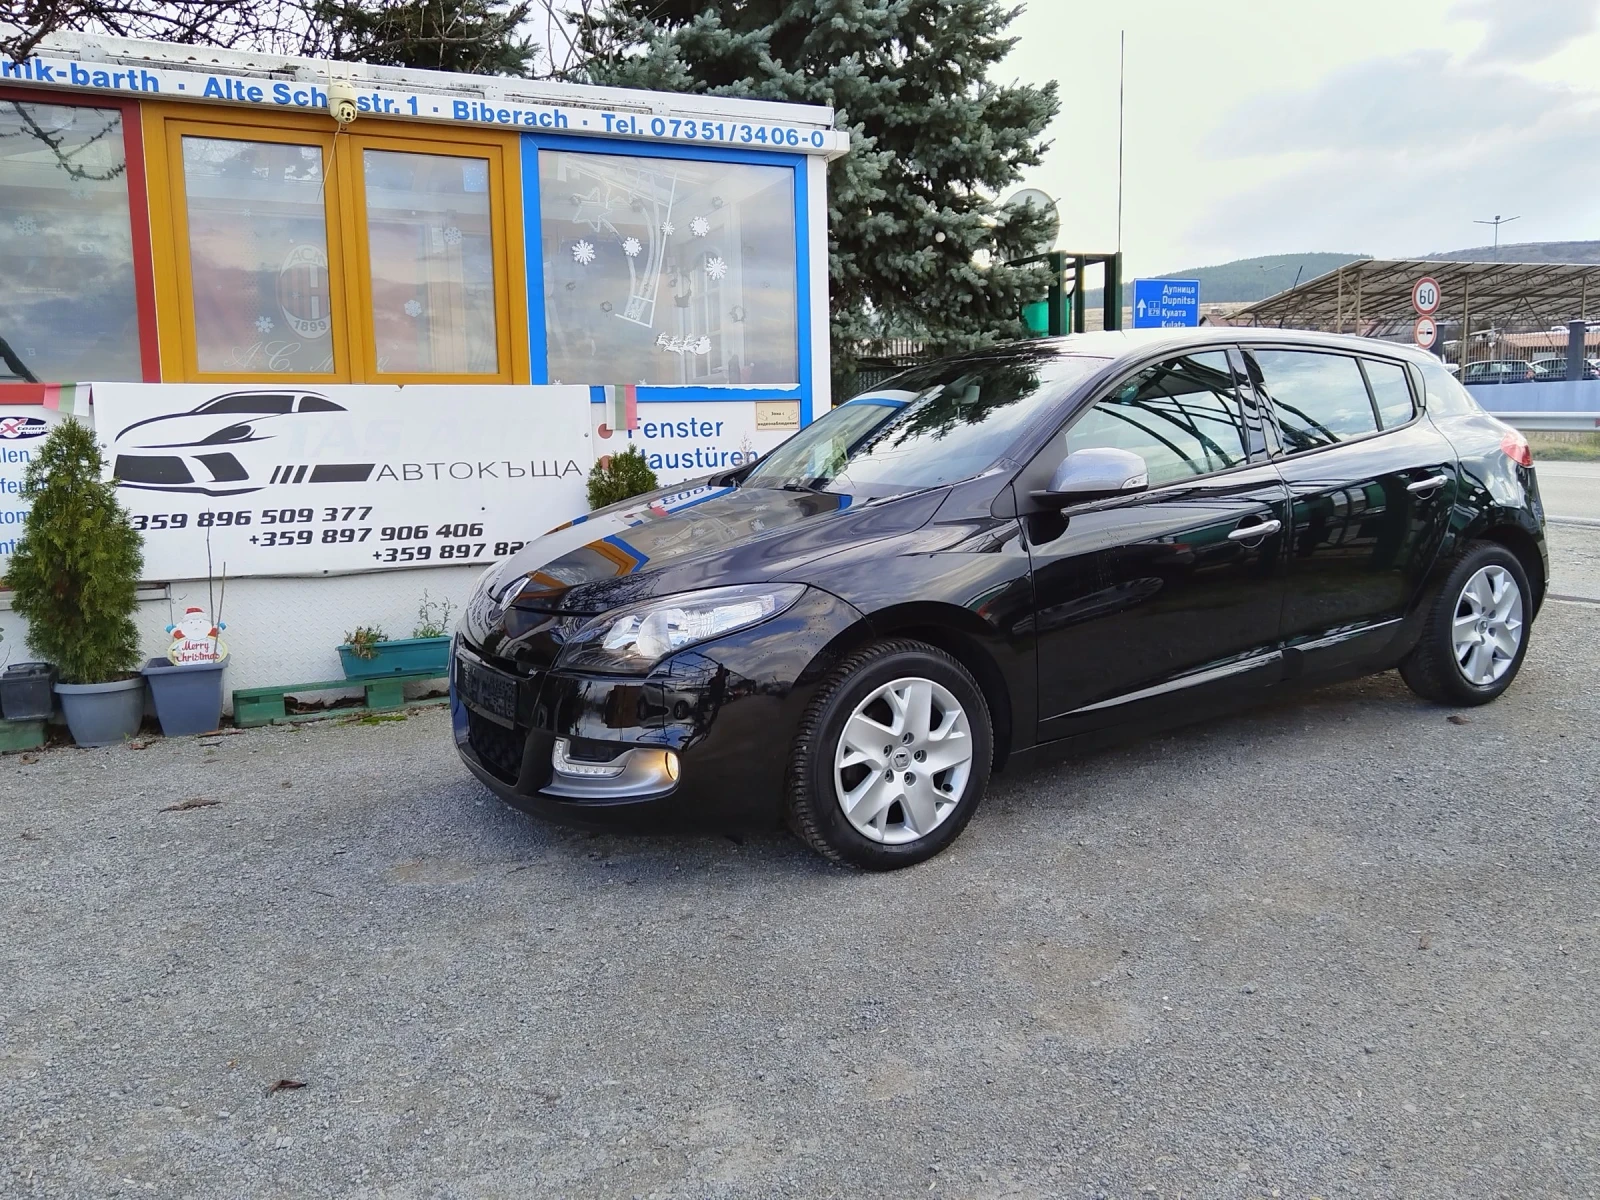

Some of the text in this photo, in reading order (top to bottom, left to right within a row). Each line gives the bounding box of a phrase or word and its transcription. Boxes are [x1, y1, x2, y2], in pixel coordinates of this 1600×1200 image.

[203, 76, 263, 101] Alte
[452, 99, 568, 128] Biberach
[601, 113, 643, 134] Tel.
[650, 117, 825, 148] 07351/3406-0
[1162, 284, 1195, 295] Дупница
[1419, 288, 1435, 305] 60
[1162, 295, 1196, 306] Dupnitsa
[1161, 308, 1187, 318] Кулата
[294, 320, 327, 332] 1899
[376, 459, 583, 482] АВТОКЪЩА
[121, 506, 373, 531] 359 896 509 377
[249, 523, 484, 547] +359 897 906 406
[372, 540, 533, 563] +359 897 82
[181, 640, 210, 653] Merry
[176, 651, 220, 663] Christmas
